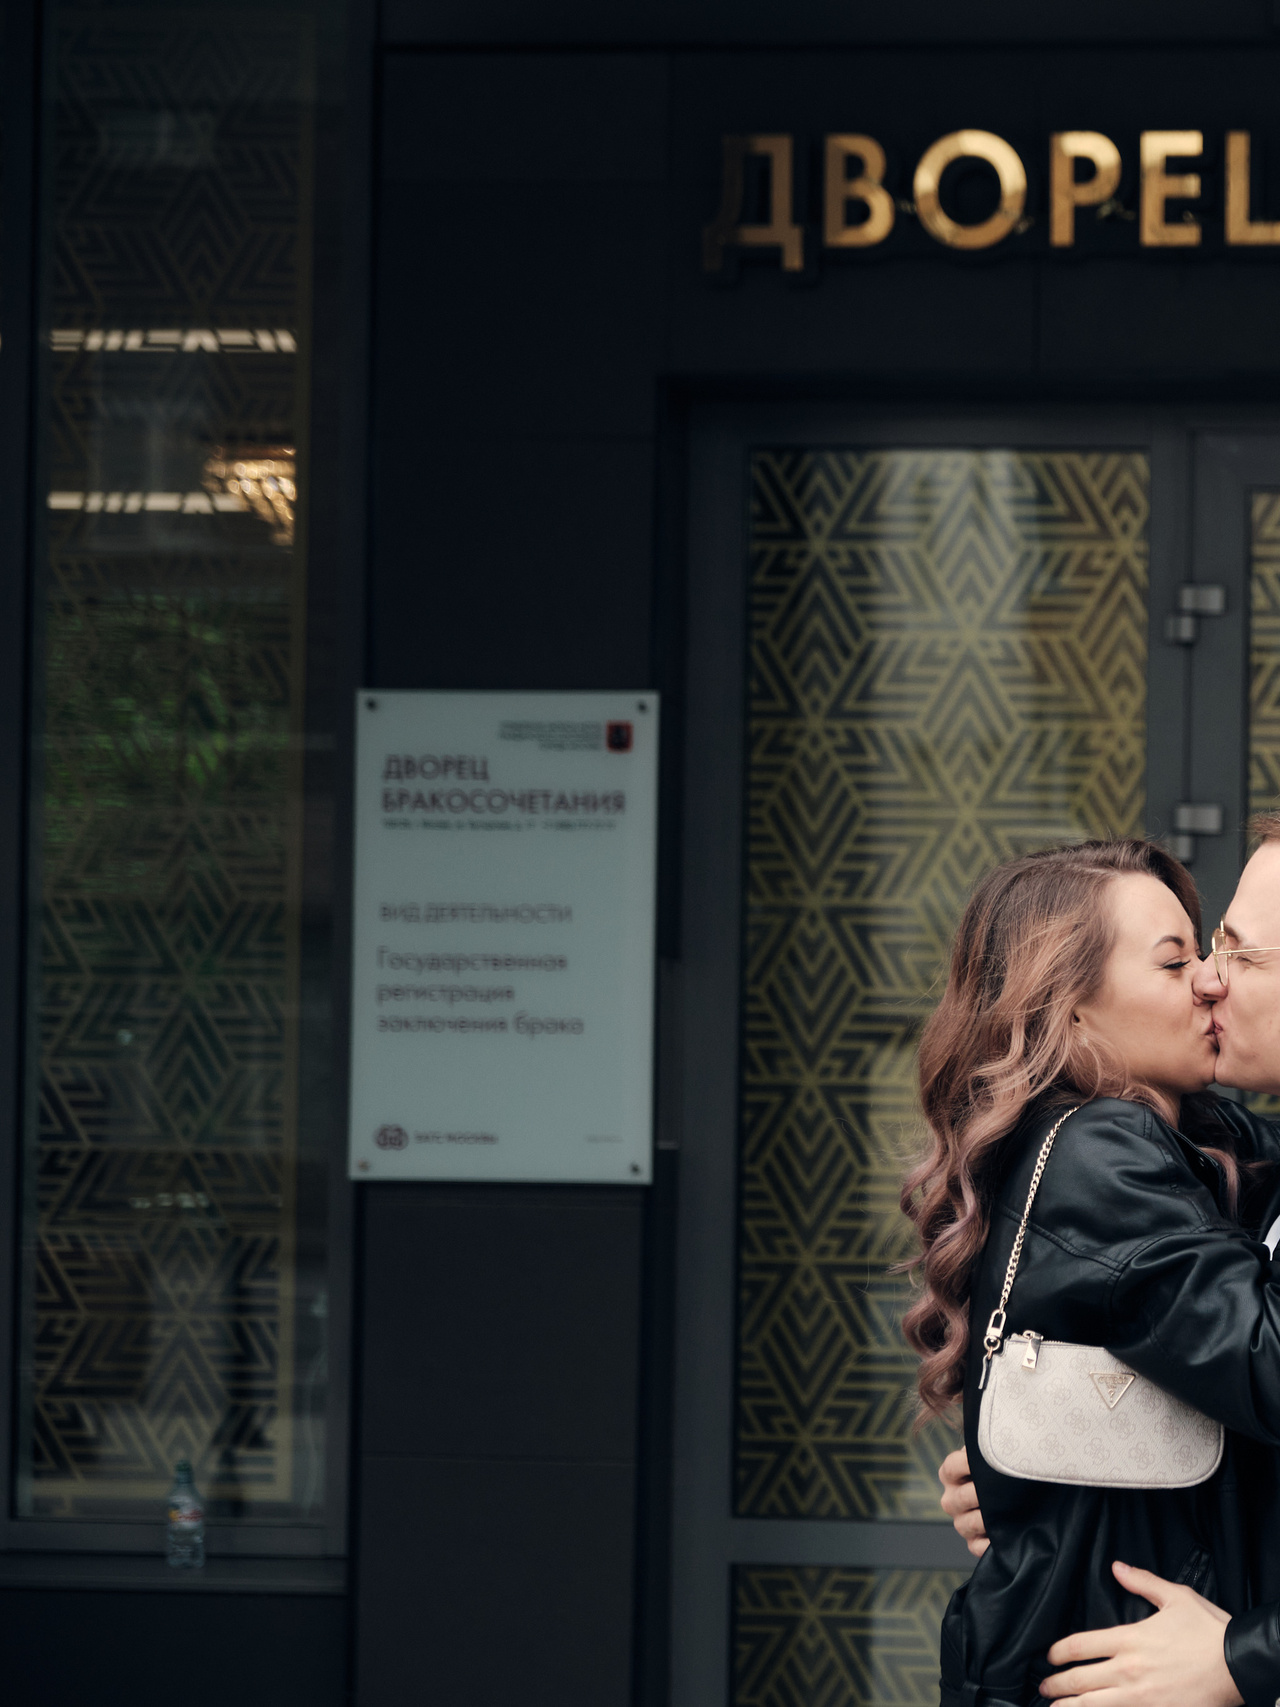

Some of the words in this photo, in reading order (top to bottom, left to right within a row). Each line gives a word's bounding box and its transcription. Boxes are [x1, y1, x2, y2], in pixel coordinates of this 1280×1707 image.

[383, 754, 489, 783] ДВОРЕЦ
[382, 788, 626, 814] БРАКОСОЧЕТАНИЯ
[379, 902, 421, 923] ВИД
